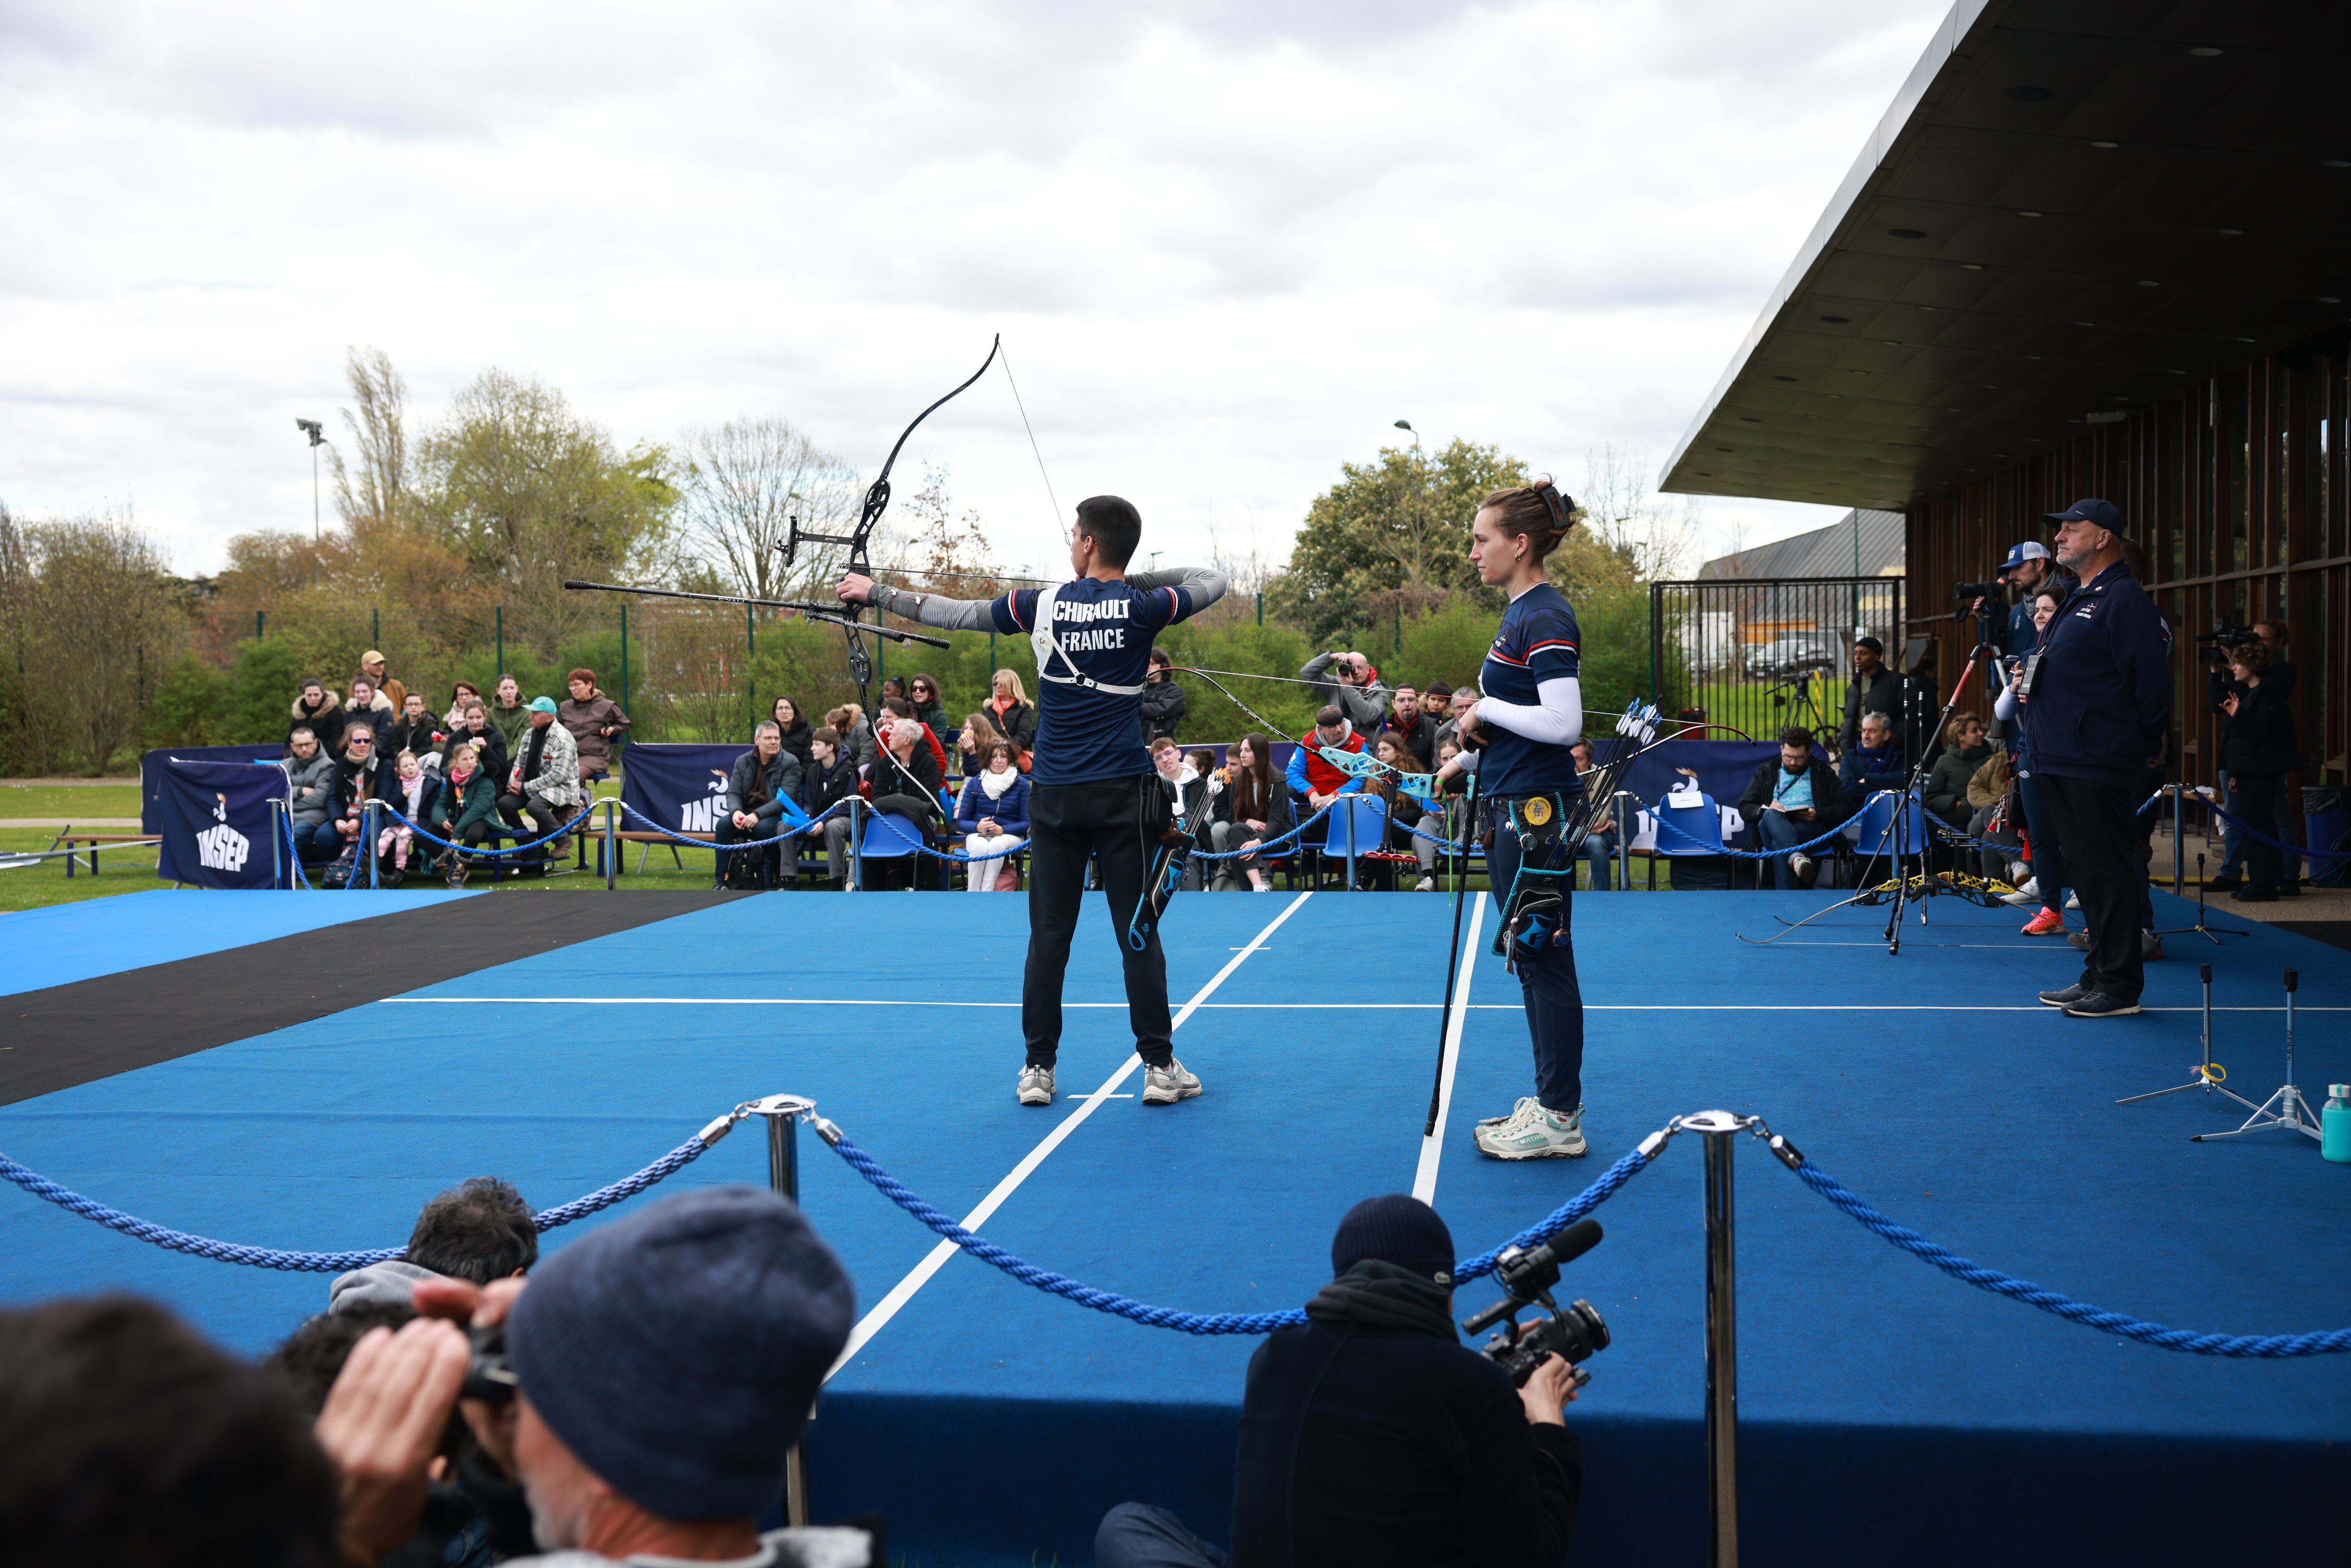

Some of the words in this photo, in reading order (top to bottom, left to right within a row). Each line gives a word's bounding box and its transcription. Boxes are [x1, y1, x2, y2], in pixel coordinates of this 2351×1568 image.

[1053, 599, 1130, 623] CHIRAULT
[1061, 628, 1125, 652] FRANCE
[196, 823, 250, 872] INSEP
